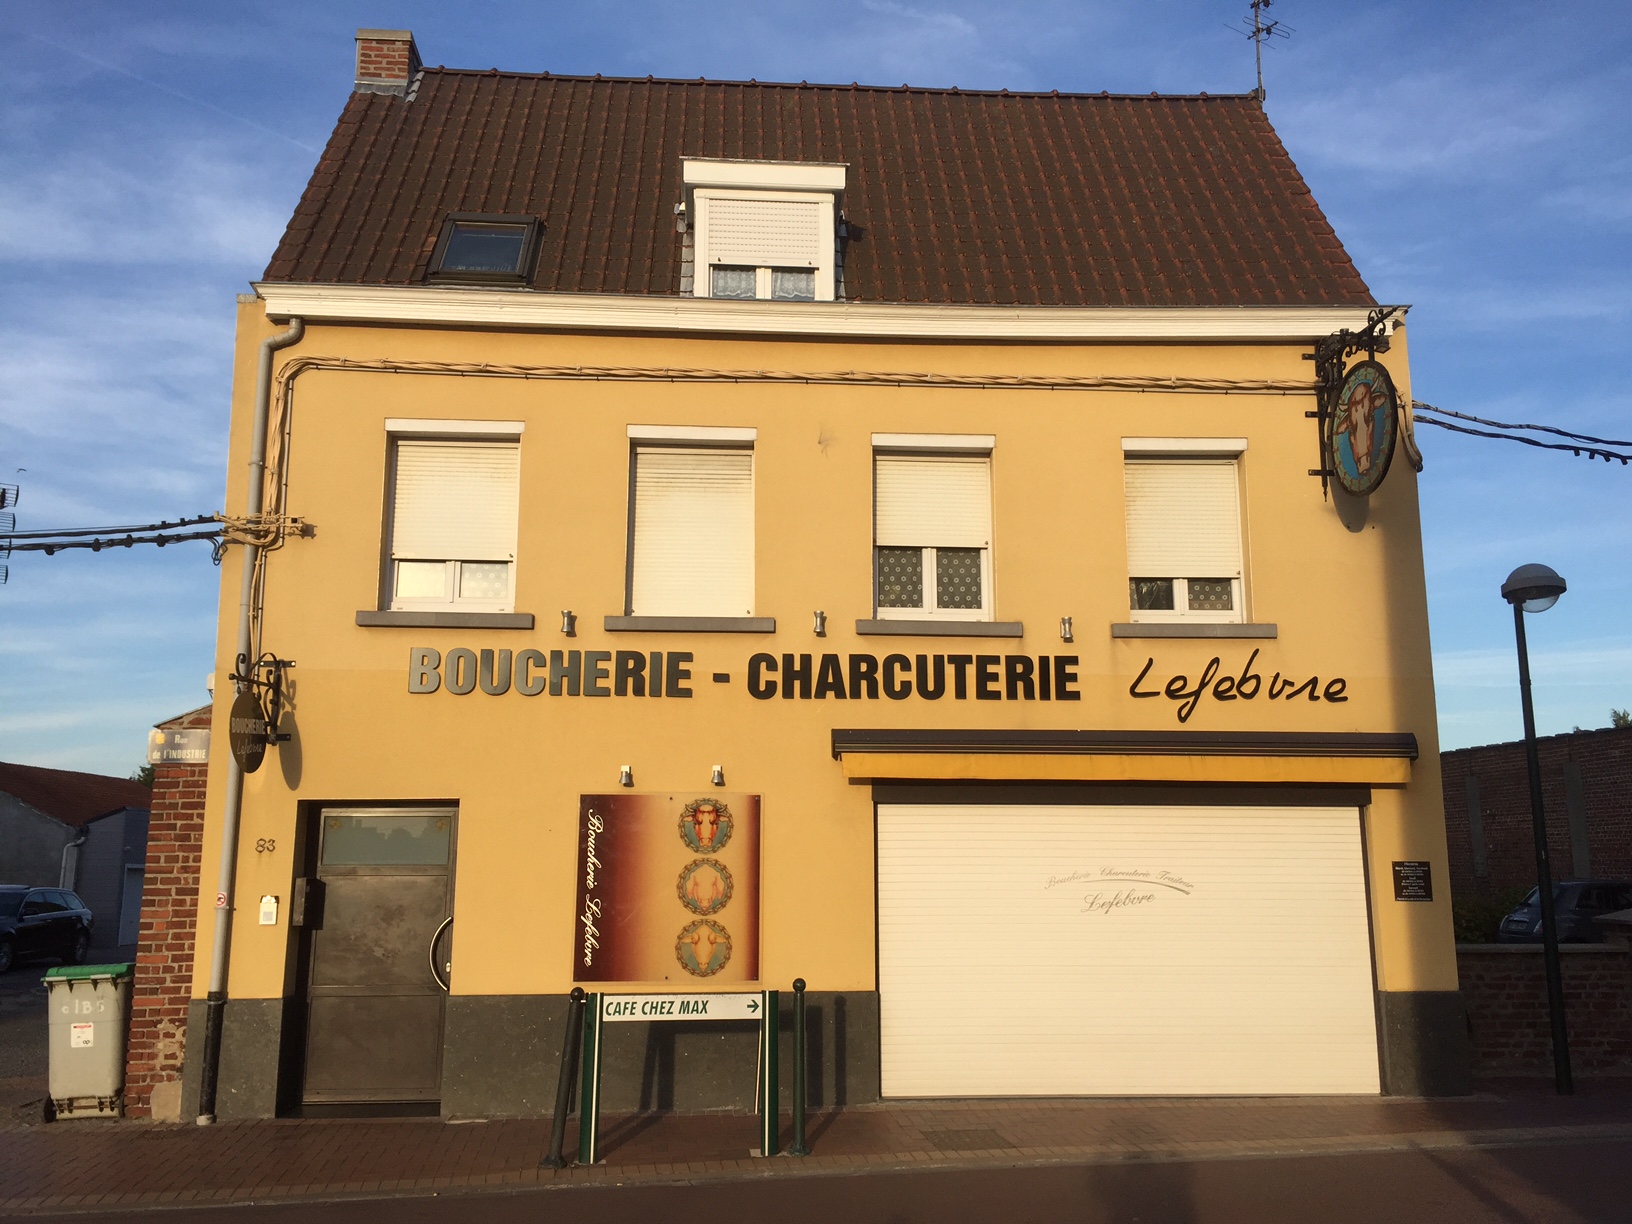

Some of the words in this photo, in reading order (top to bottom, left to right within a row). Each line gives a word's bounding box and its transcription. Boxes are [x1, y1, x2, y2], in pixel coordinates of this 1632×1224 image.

[408, 647, 694, 698] BOUCHERIE
[712, 673, 731, 683] -
[747, 652, 1081, 701] CHARCUTERIE
[1129, 648, 1349, 724] Lefebvre
[231, 717, 266, 735] BOUCHERIE
[255, 838, 276, 853] 83
[586, 808, 604, 890] Boucherie
[1044, 870, 1091, 890] Boucherie
[1100, 866, 1151, 878] Charcuterie
[1155, 870, 1194, 889] Traiteur
[1080, 888, 1155, 915] Lefebvre
[581, 893, 602, 968] Lefebvre
[605, 1001, 638, 1016] CAFE
[641, 1000, 674, 1015] CHEZ
[678, 1000, 709, 1015] MAX
